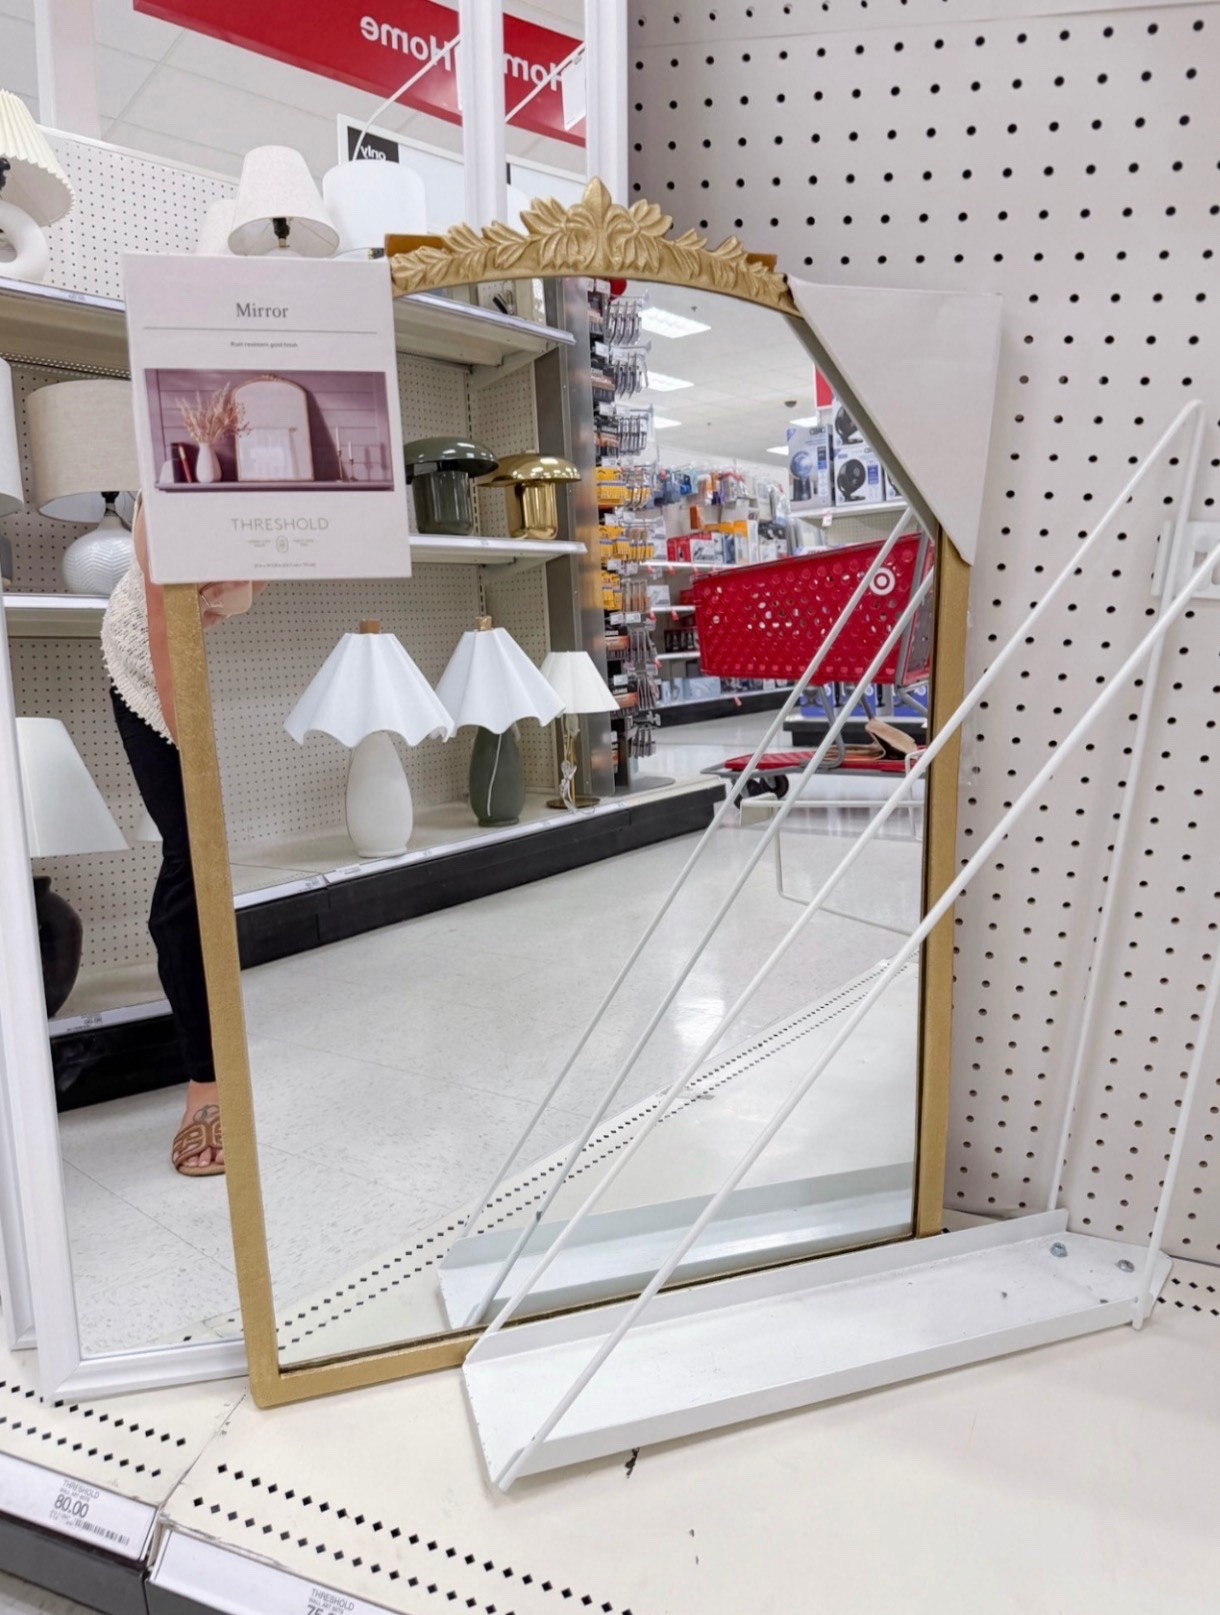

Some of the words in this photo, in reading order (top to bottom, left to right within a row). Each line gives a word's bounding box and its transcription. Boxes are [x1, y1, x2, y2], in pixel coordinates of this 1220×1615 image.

[236, 302, 288, 318] Mirror
[231, 517, 329, 531] THRESHOLD
[54, 1493, 90, 1518] 80.00
[311, 1588, 355, 1611] THRESHOLD
